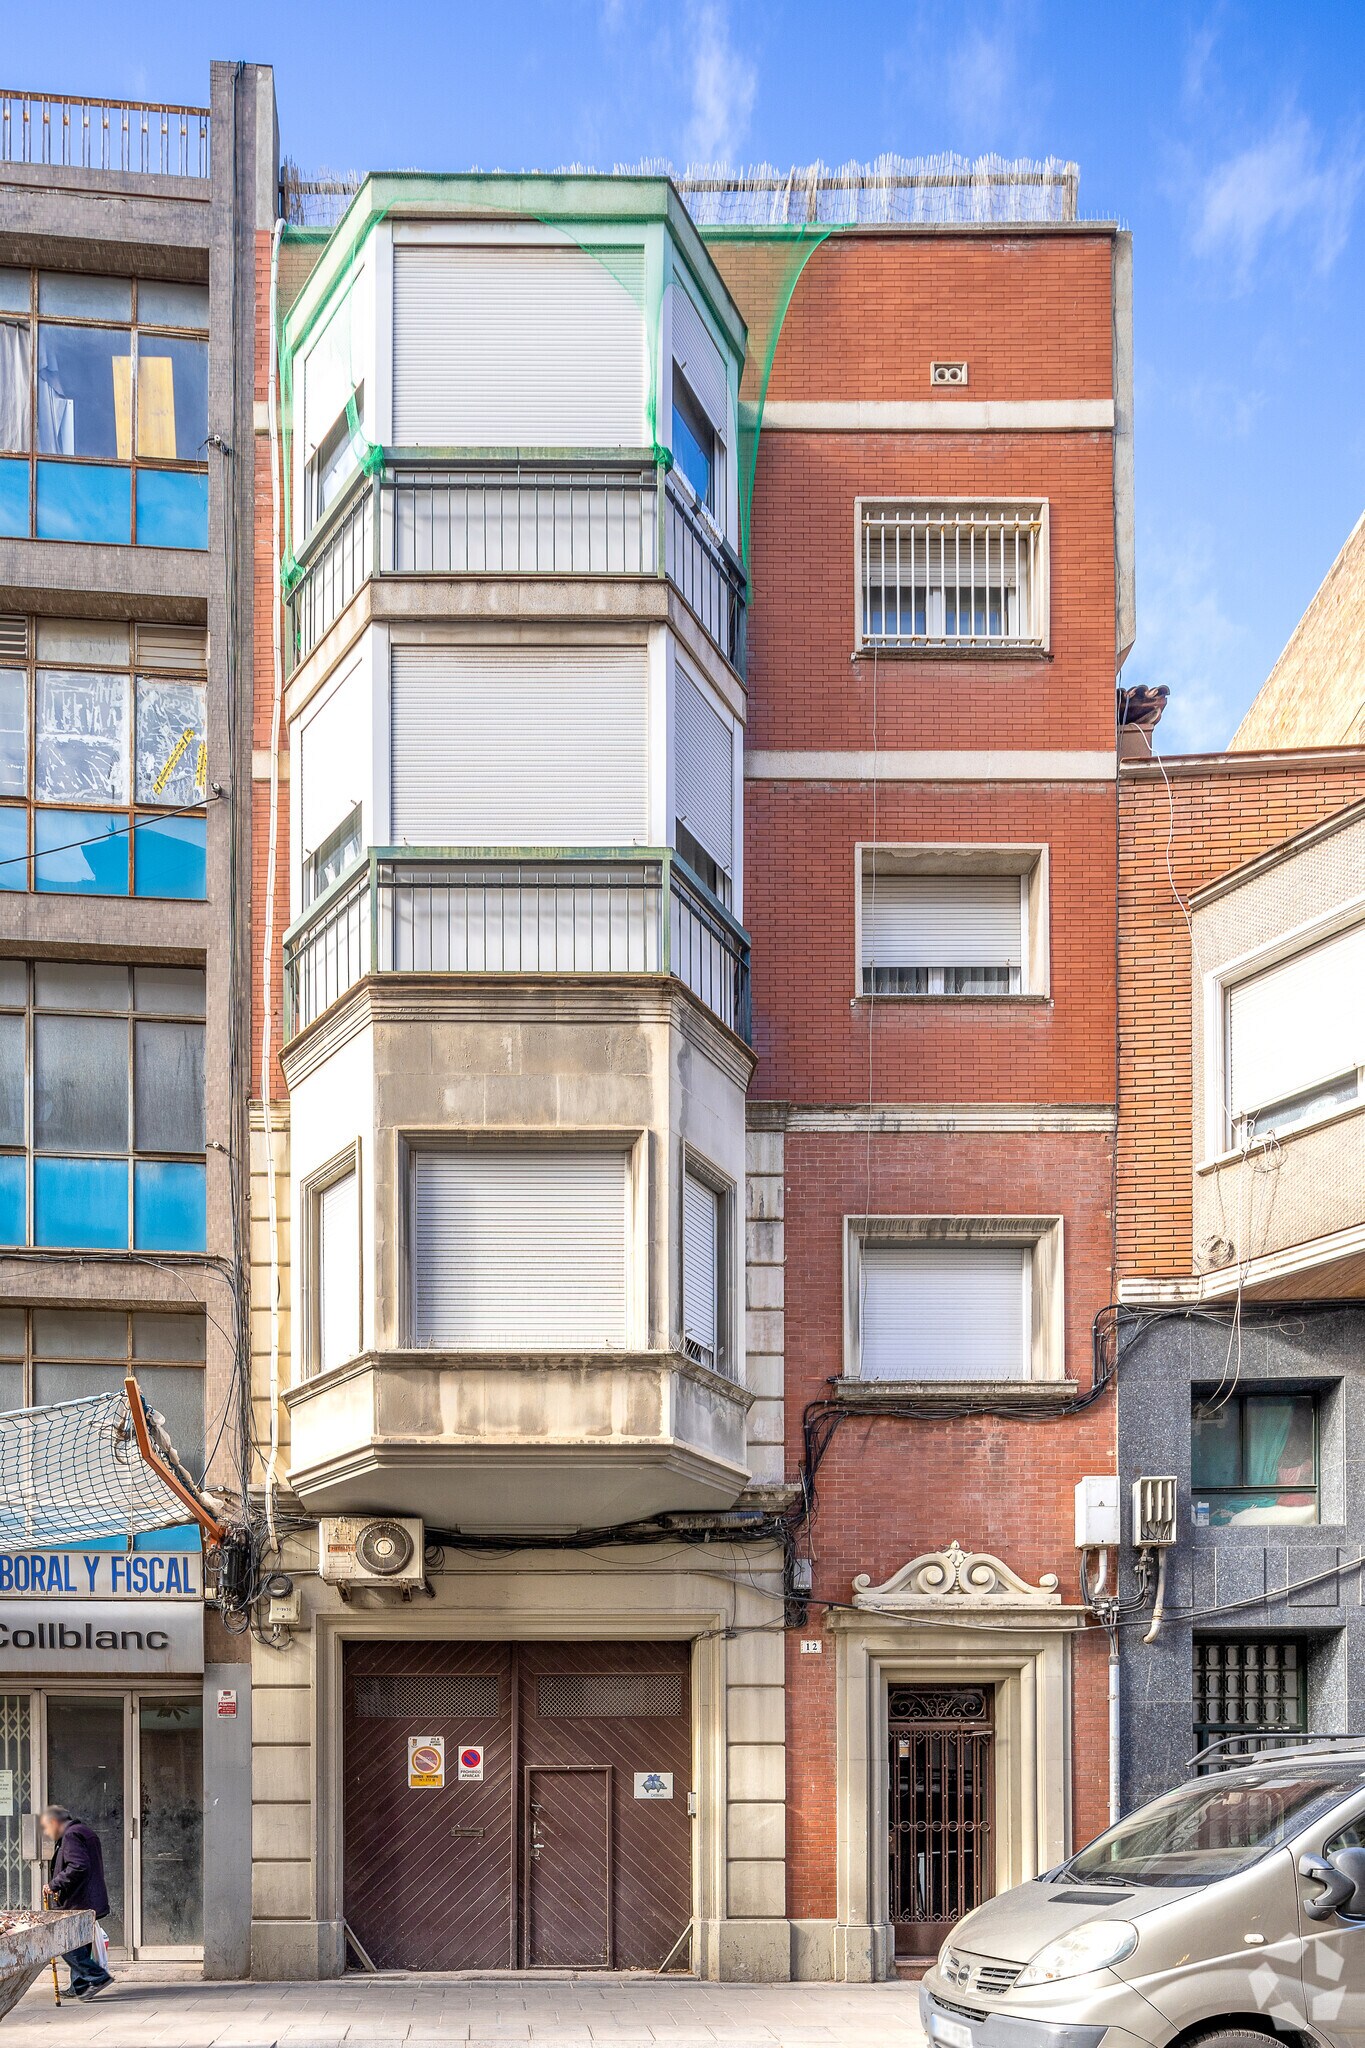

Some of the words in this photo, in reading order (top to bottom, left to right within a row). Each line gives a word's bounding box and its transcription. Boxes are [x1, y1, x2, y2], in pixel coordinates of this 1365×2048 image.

[0, 1555, 77, 1591] BORAL
[83, 1556, 100, 1592] Y
[111, 1556, 196, 1593] FISCAL
